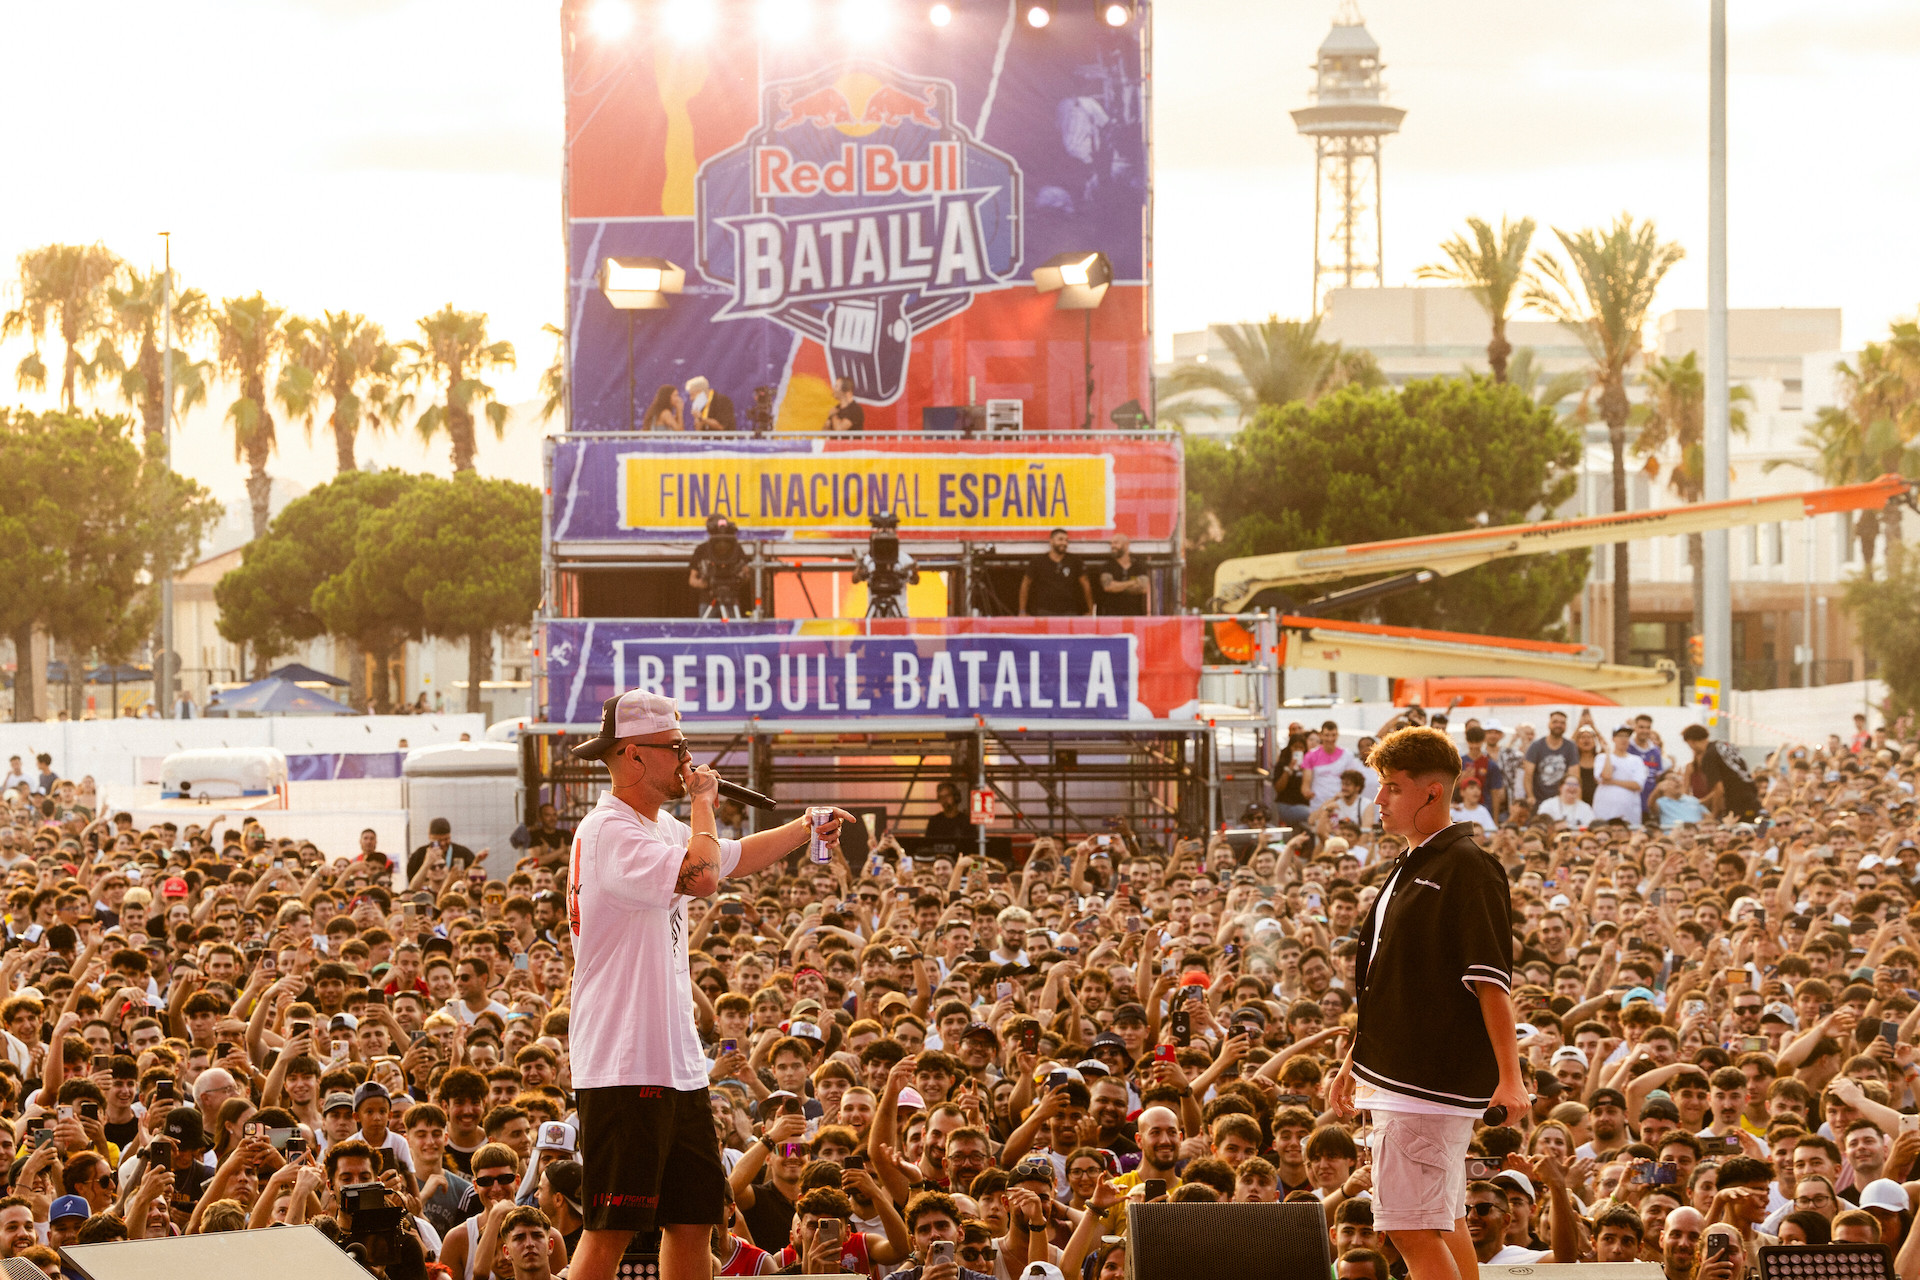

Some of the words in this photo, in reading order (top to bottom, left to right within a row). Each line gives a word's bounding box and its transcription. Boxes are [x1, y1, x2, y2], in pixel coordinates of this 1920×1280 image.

[759, 144, 856, 194] Red
[864, 143, 958, 193] Bull
[742, 200, 983, 307] BATALLA
[660, 473, 750, 518] FINAL
[760, 473, 928, 518] NACIONAL
[938, 463, 1070, 518] ESPAÑA
[638, 652, 872, 712] REDBULL
[893, 650, 1119, 710] BATALLA
[639, 1086, 664, 1099] UFC
[623, 1195, 647, 1203] FIGHT
